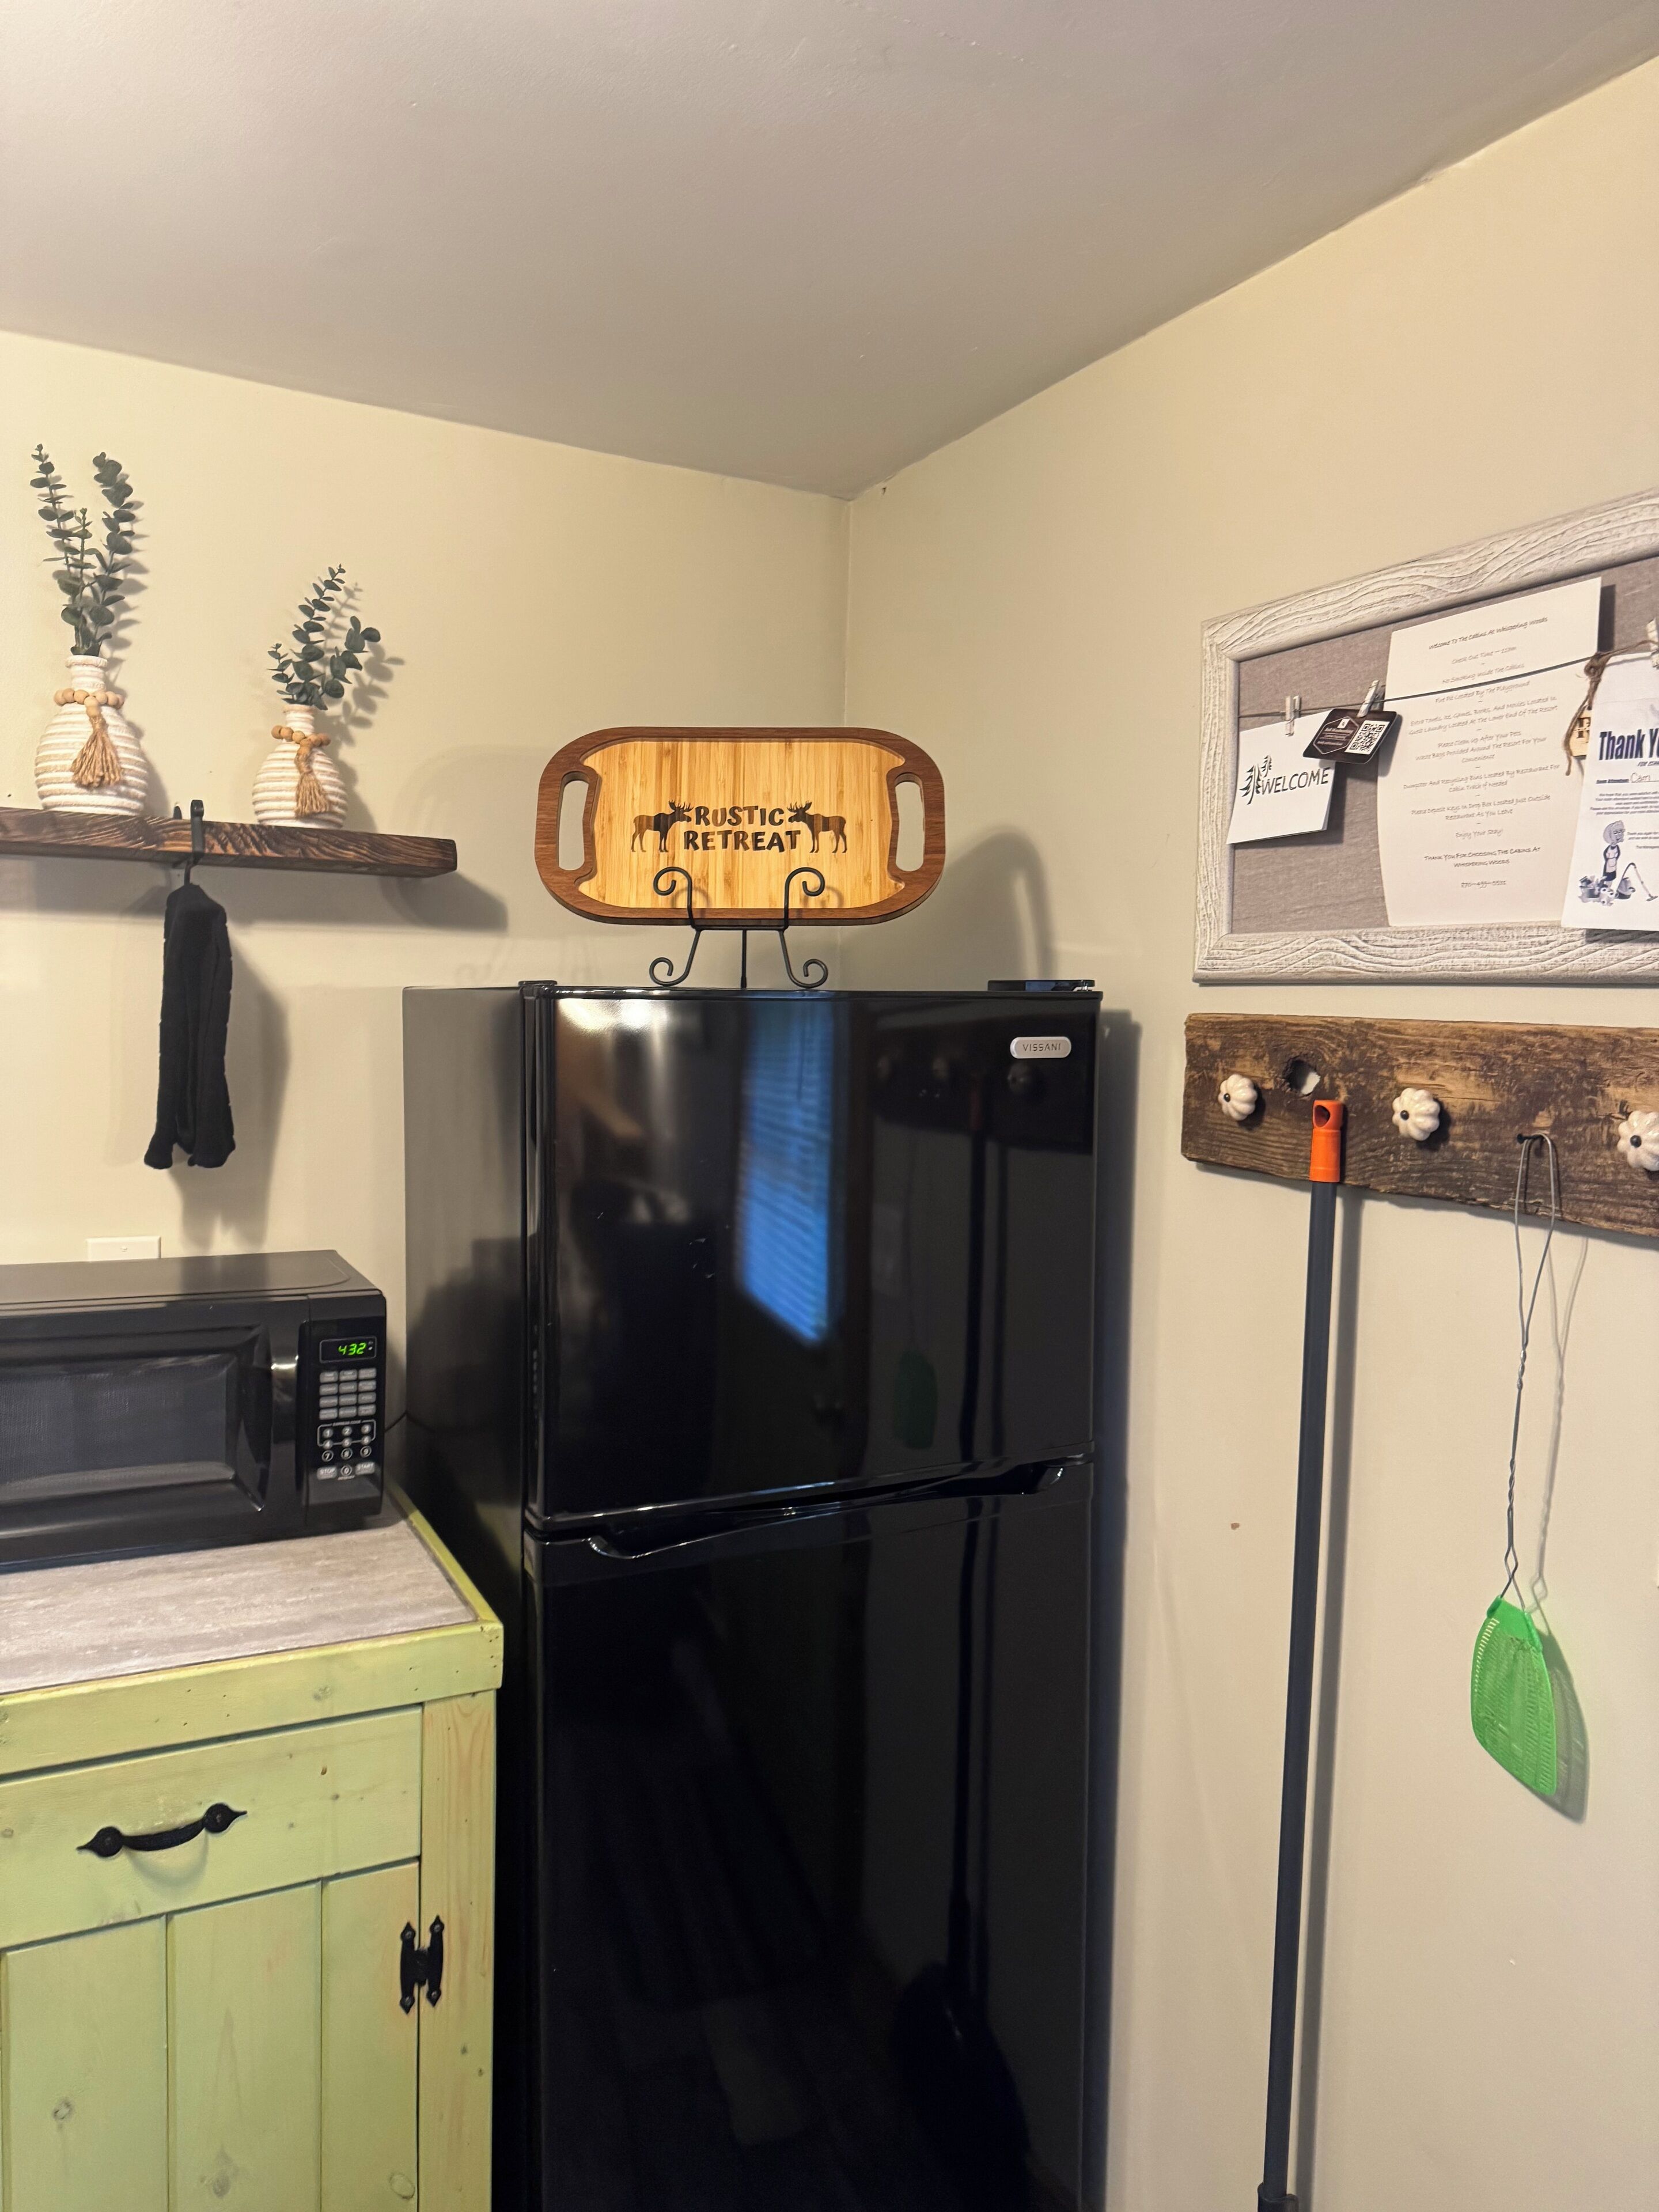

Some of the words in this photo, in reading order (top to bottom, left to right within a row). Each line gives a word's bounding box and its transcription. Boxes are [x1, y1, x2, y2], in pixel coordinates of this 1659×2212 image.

[1468, 632, 1487, 640] Cabins
[1497, 622, 1528, 633] Whispering
[1599, 729, 1646, 760] Thank
[1262, 767, 1331, 795] WELCOME
[695, 805, 784, 826] RUSTIC
[684, 830, 801, 853] RETREAT
[1022, 1043, 1061, 1051] VISSANI
[358, 1462, 374, 1470] START
